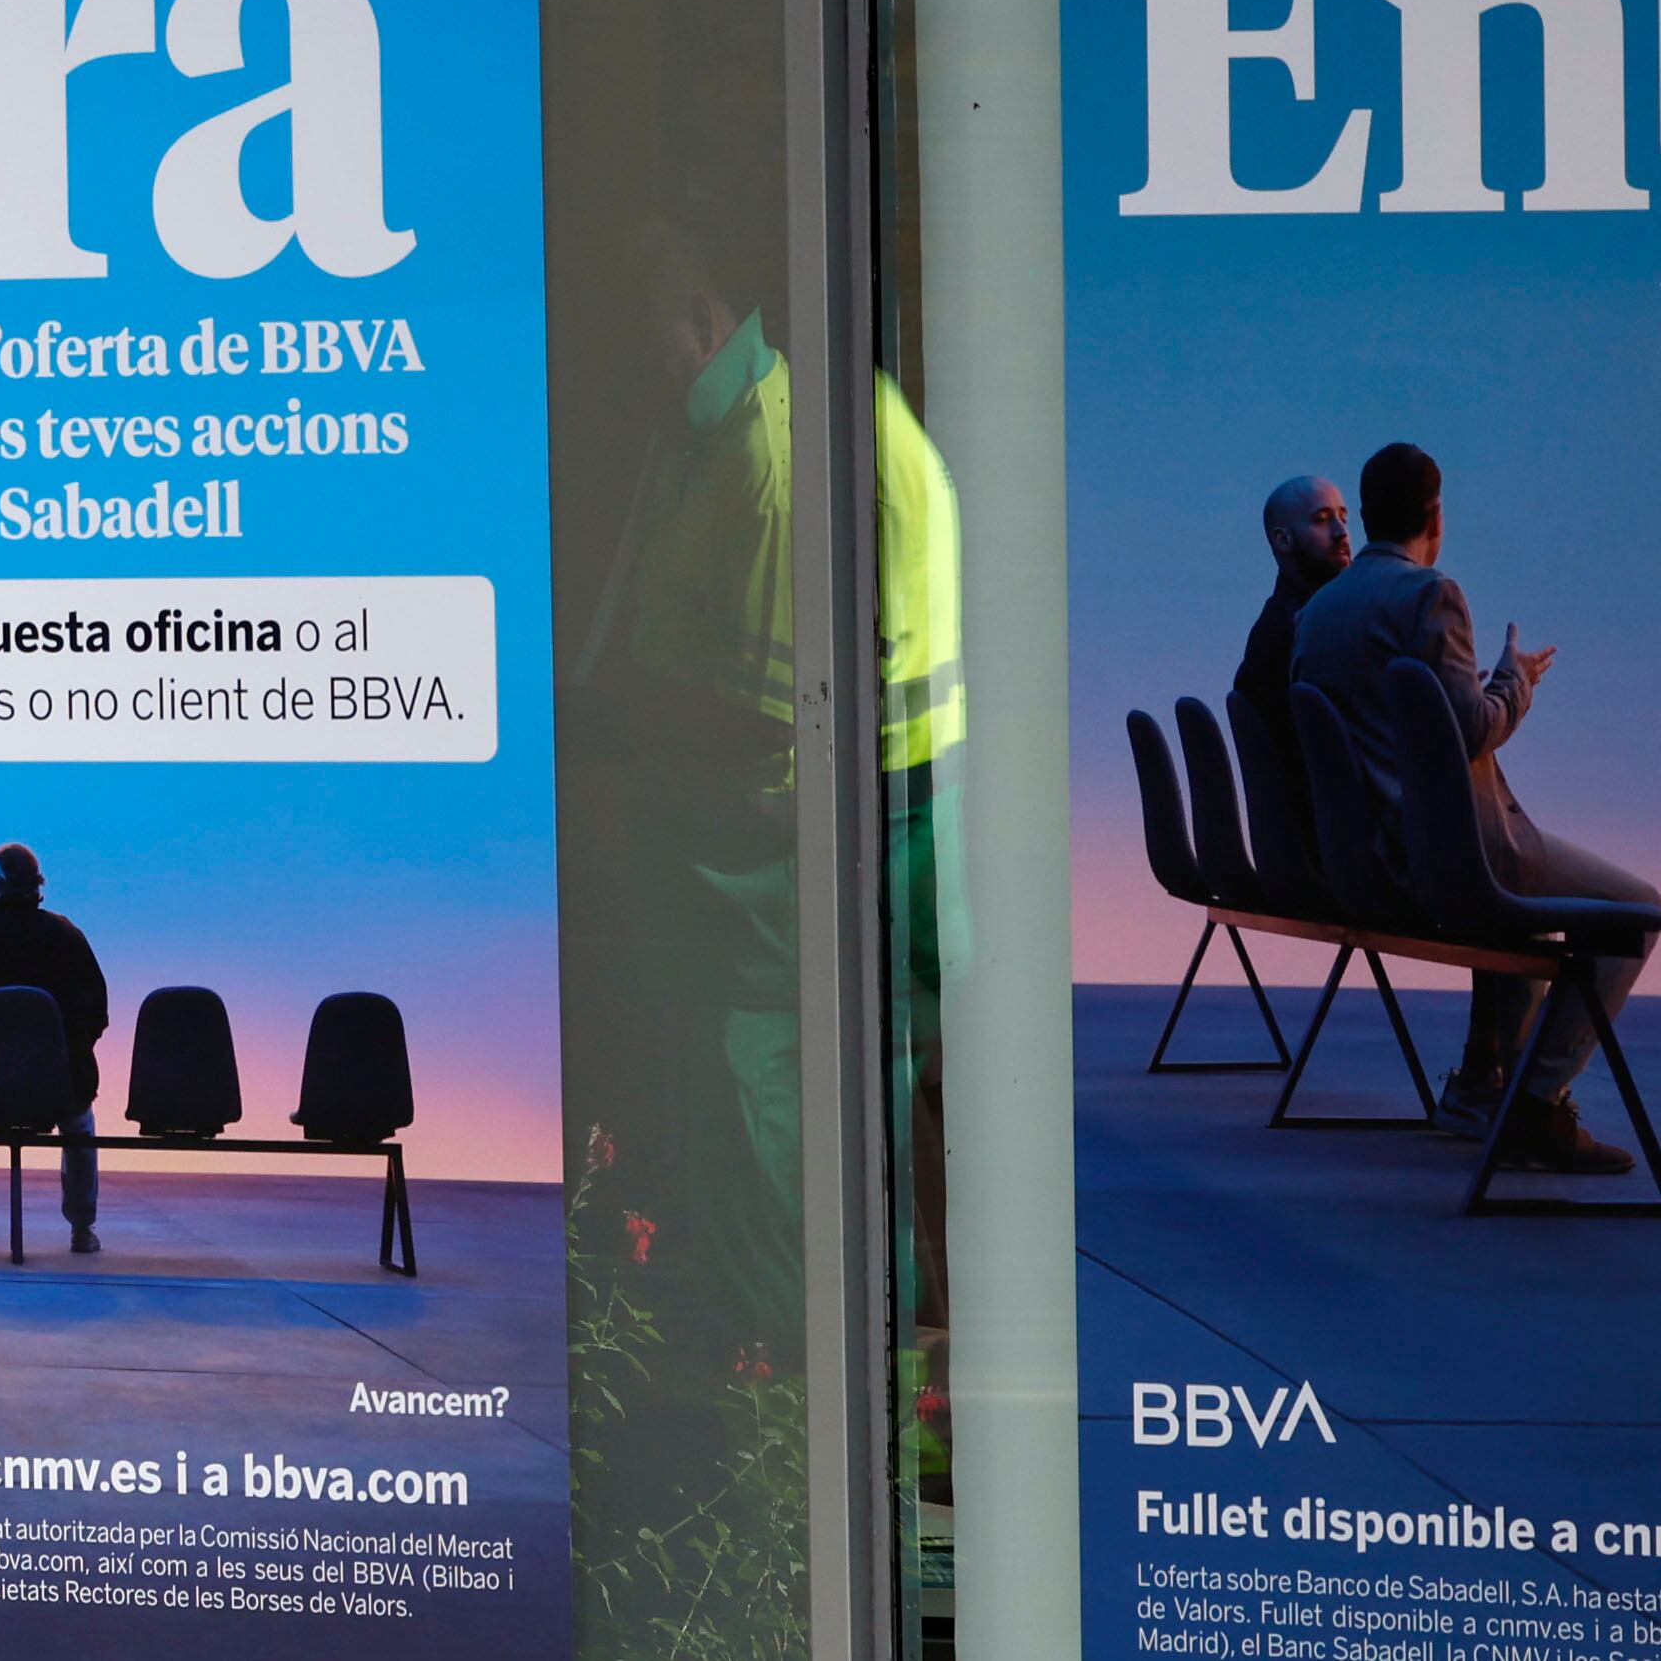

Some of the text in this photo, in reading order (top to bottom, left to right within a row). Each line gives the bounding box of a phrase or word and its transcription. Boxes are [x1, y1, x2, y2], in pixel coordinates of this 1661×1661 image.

[180, 318, 248, 375] de
[260, 320, 425, 373] BBVA
[37, 410, 181, 458] teves
[192, 398, 408, 456] accions
[0, 480, 242, 540] Sabadell
[126, 609, 281, 652] oficina
[296, 620, 320, 652] o
[335, 608, 367, 651] al
[29, 689, 52, 720] o
[68, 689, 117, 720] no
[133, 678, 248, 720] client
[263, 677, 313, 720] de
[331, 677, 463, 720] BBVA.
[349, 1382, 509, 1417] Avancem?
[1133, 1381, 1336, 1448] BBVA
[177, 1450, 187, 1495] i
[203, 1463, 228, 1496] a
[244, 1453, 467, 1505] bbva.com
[16, 1519, 135, 1544] autoritzada
[140, 1528, 175, 1550] per
[179, 1524, 196, 1546] la
[201, 1524, 299, 1550] Comissió
[304, 1528, 396, 1554] Nacional
[401, 1533, 432, 1556] del
[438, 1534, 513, 1559] Mercat
[1138, 1490, 1661, 1557] Fullet disponible a cn
[98, 1552, 134, 1574] així
[142, 1559, 187, 1576] com
[196, 1561, 207, 1577] a
[217, 1556, 246, 1579] les
[255, 1563, 304, 1581] seus
[313, 1560, 343, 1583] del
[354, 1561, 414, 1586] BBVA
[423, 1565, 499, 1592] (Bilbao
[1228, 1569, 1291, 1593] sobre
[1298, 1570, 1370, 1596] Banco
[1376, 1575, 1403, 1598] de
[1409, 1576, 1515, 1606] Sabadell,
[1522, 1582, 1567, 1606] S.A.
[1574, 1585, 1601, 1608] ha
[66, 1580, 157, 1606] Rectores
[164, 1585, 189, 1607] de
[196, 1586, 224, 1609] les
[231, 1587, 304, 1612] Borses
[310, 1591, 335, 1613] de
[341, 1592, 412, 1617] Valors.
[1138, 1596, 1165, 1619] de
[1174, 1597, 1251, 1624] Valors.
[1262, 1601, 1322, 1626] Fullet
[1333, 1605, 1453, 1634] disponible
[1464, 1617, 1475, 1634] a
[1487, 1618, 1584, 1640] cnmv.es
[1610, 1626, 1622, 1642] a
[1139, 1627, 1234, 1659] Madrid),
[1242, 1633, 1259, 1655] el
[1269, 1634, 1325, 1659] Banc
[1334, 1636, 1440, 1661] Sabadell
